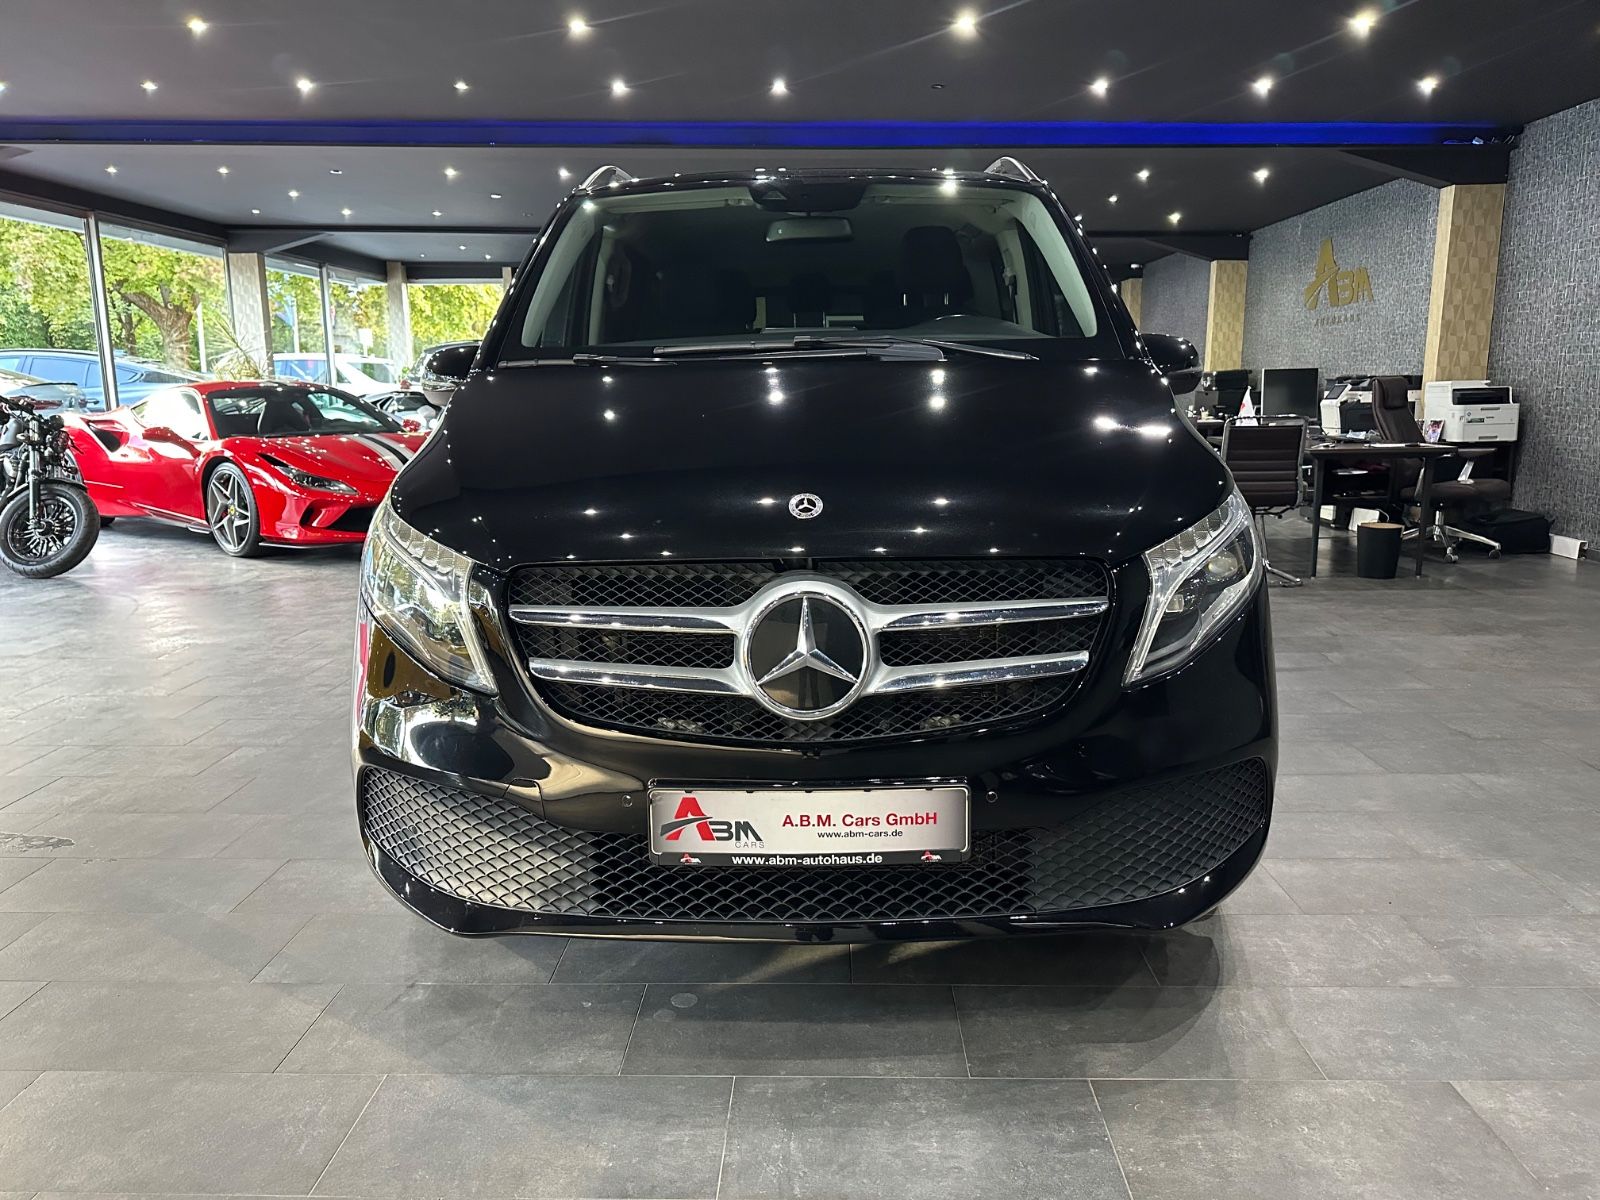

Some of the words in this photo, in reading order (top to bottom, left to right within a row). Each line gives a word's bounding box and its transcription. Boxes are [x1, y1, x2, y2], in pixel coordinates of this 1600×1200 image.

[1304, 236, 1374, 311] ABM
[660, 797, 763, 841] ABM
[782, 814, 836, 827] A.B.M.
[842, 813, 880, 827] Cars
[886, 812, 937, 826] GmbH
[817, 829, 903, 838] www.abm-cars.de
[735, 841, 765, 849] CARS
[732, 853, 882, 866] www.abm-autohaus.de
